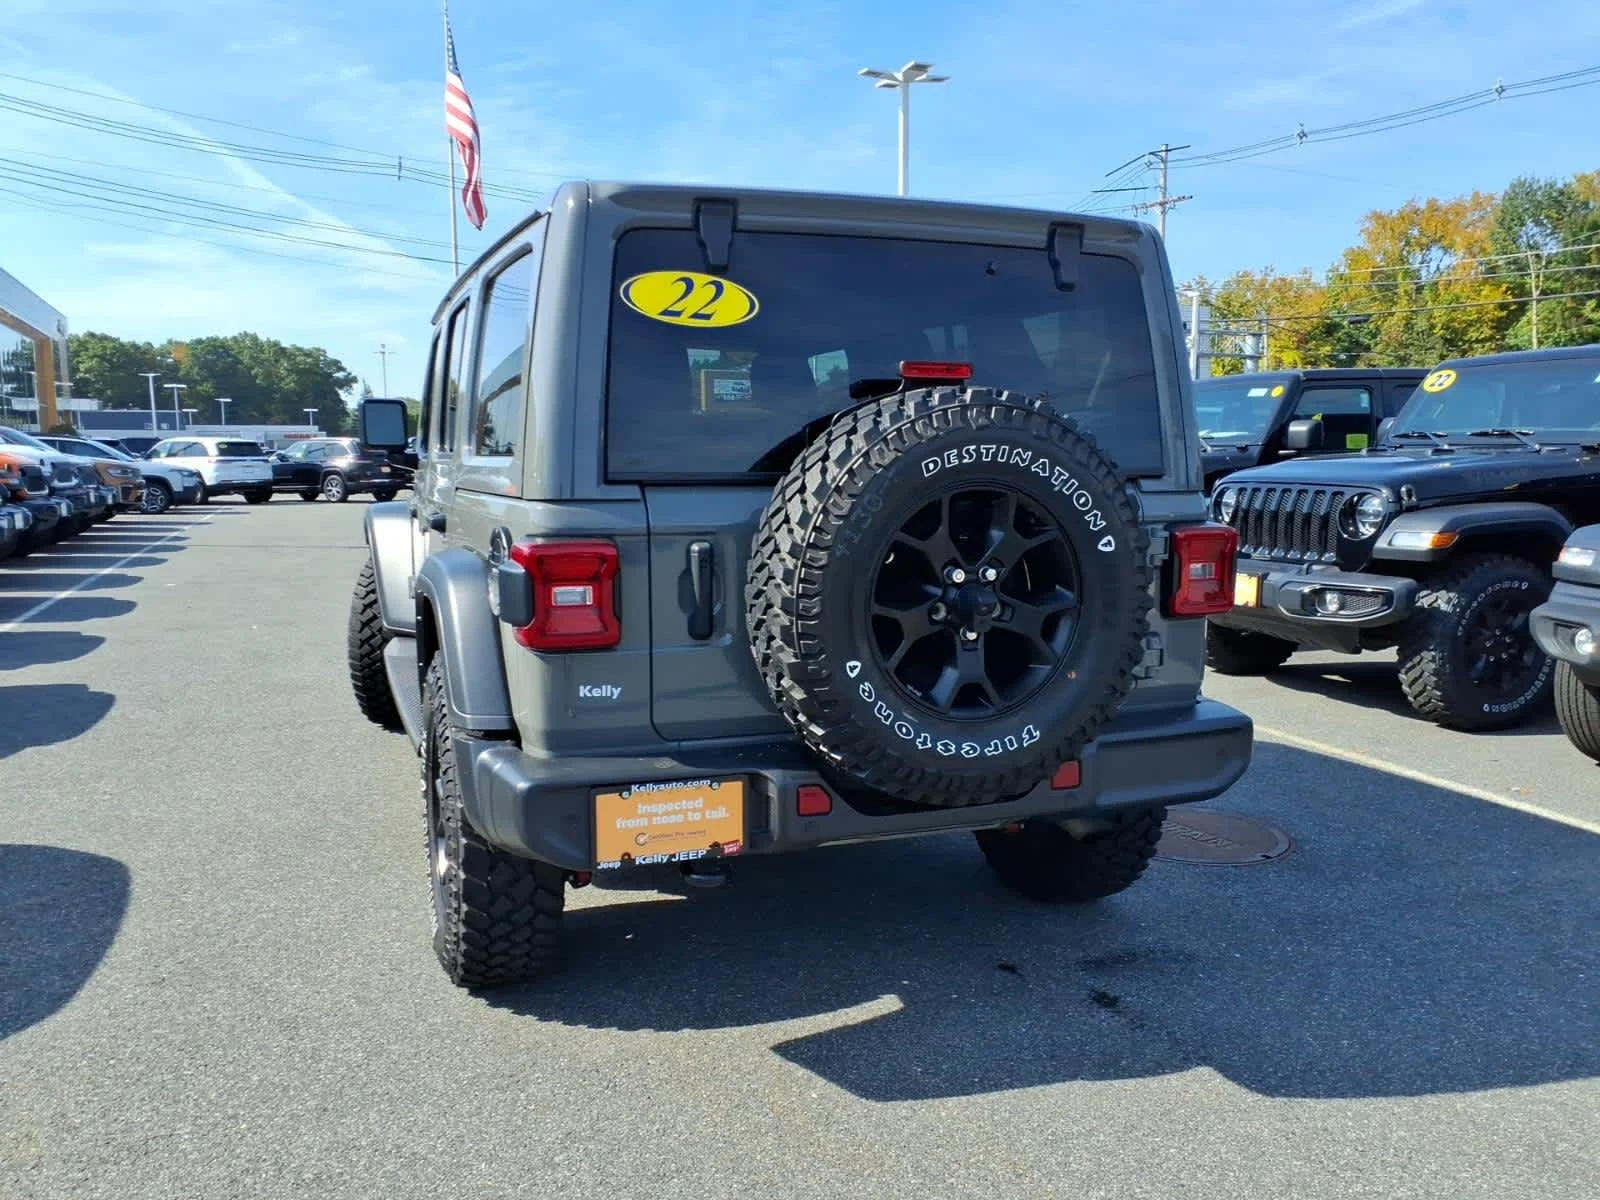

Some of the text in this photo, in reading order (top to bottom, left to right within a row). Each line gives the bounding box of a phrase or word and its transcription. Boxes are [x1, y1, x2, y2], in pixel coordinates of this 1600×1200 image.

[658, 276, 725, 321] 22
[920, 444, 1108, 532] DESTINATION
[578, 684, 622, 700] Kelly
[857, 680, 1042, 759] Firestone
[631, 778, 712, 795] Kellyauto.com
[637, 797, 704, 816] Inspected
[615, 815, 649, 830] from
[652, 812, 685, 826] nose
[688, 809, 702, 823] to
[596, 860, 622, 870] Jeep
[635, 849, 707, 866] Kelly JEEP
